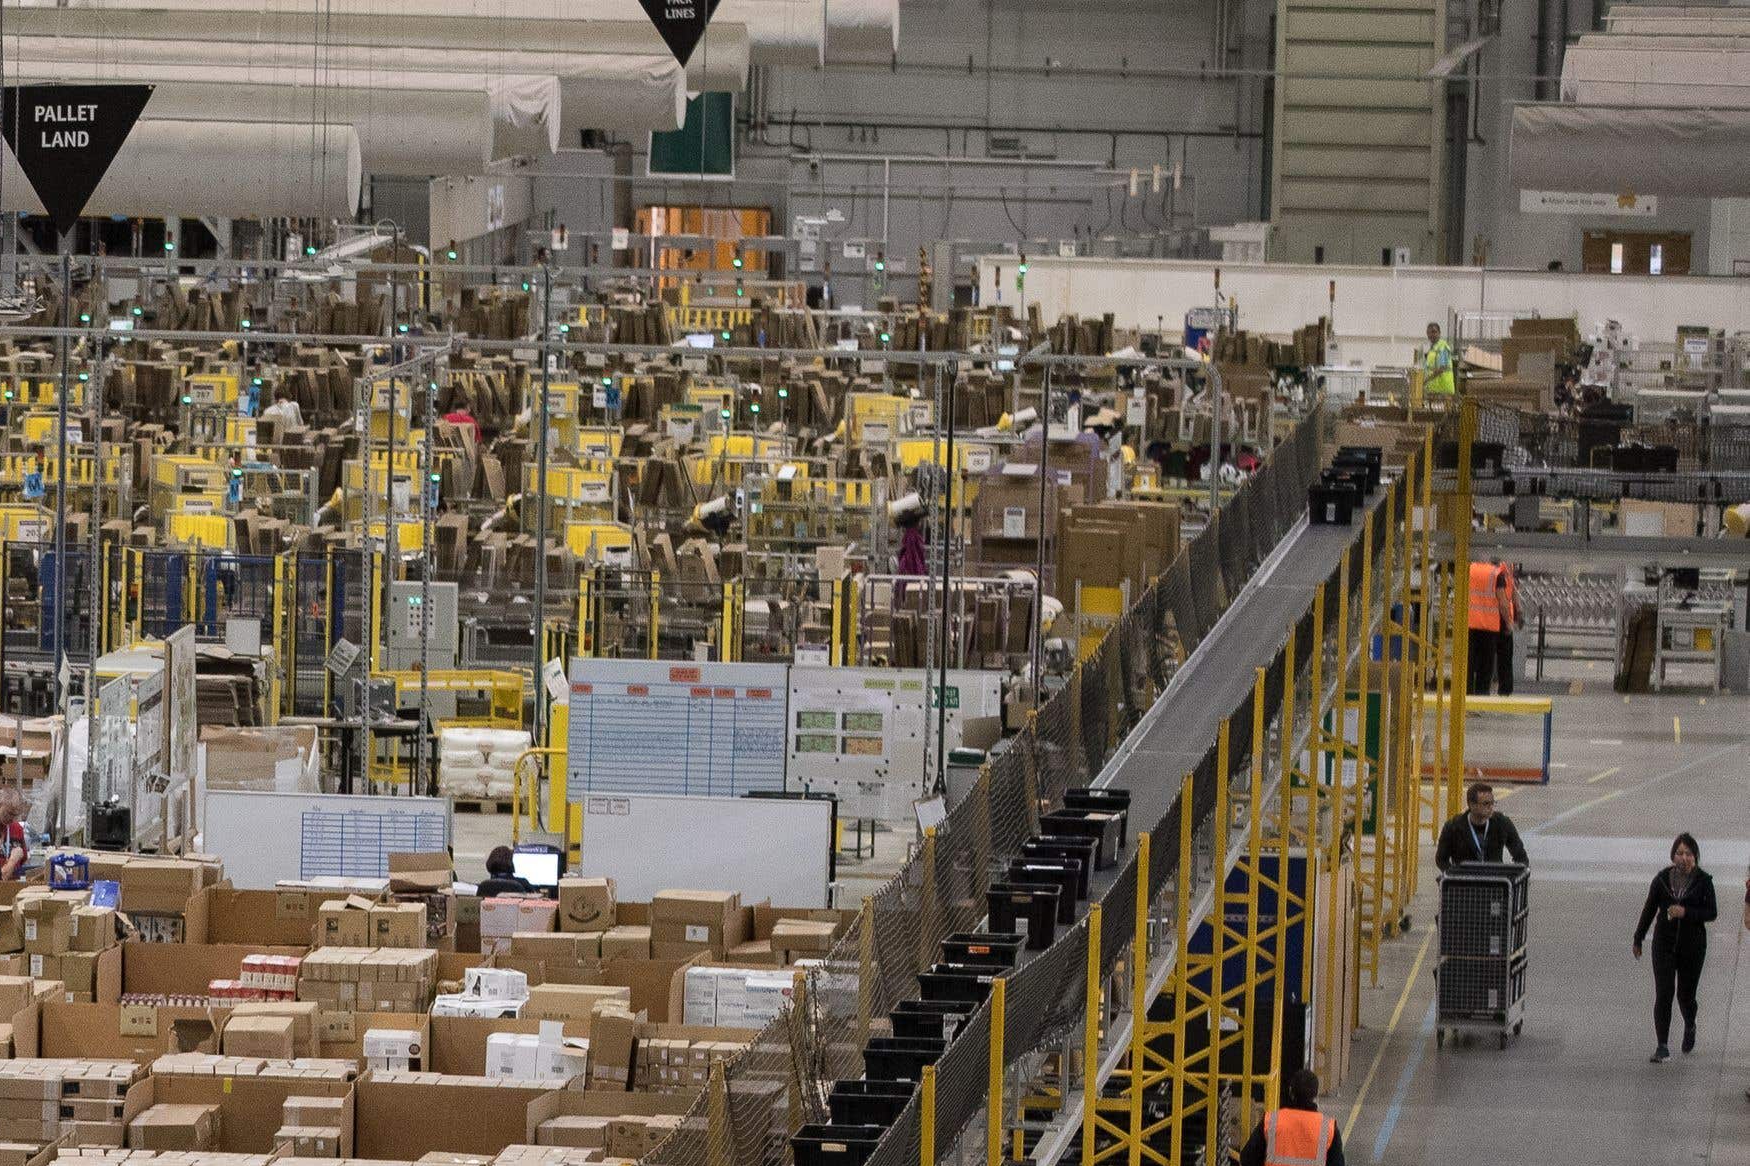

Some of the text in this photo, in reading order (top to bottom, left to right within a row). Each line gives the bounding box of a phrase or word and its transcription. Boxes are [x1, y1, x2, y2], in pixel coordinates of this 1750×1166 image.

[665, 8, 696, 19] LINES
[34, 105, 98, 122] PALLET
[41, 131, 90, 148] LAND
[28, 478, 41, 491] M
